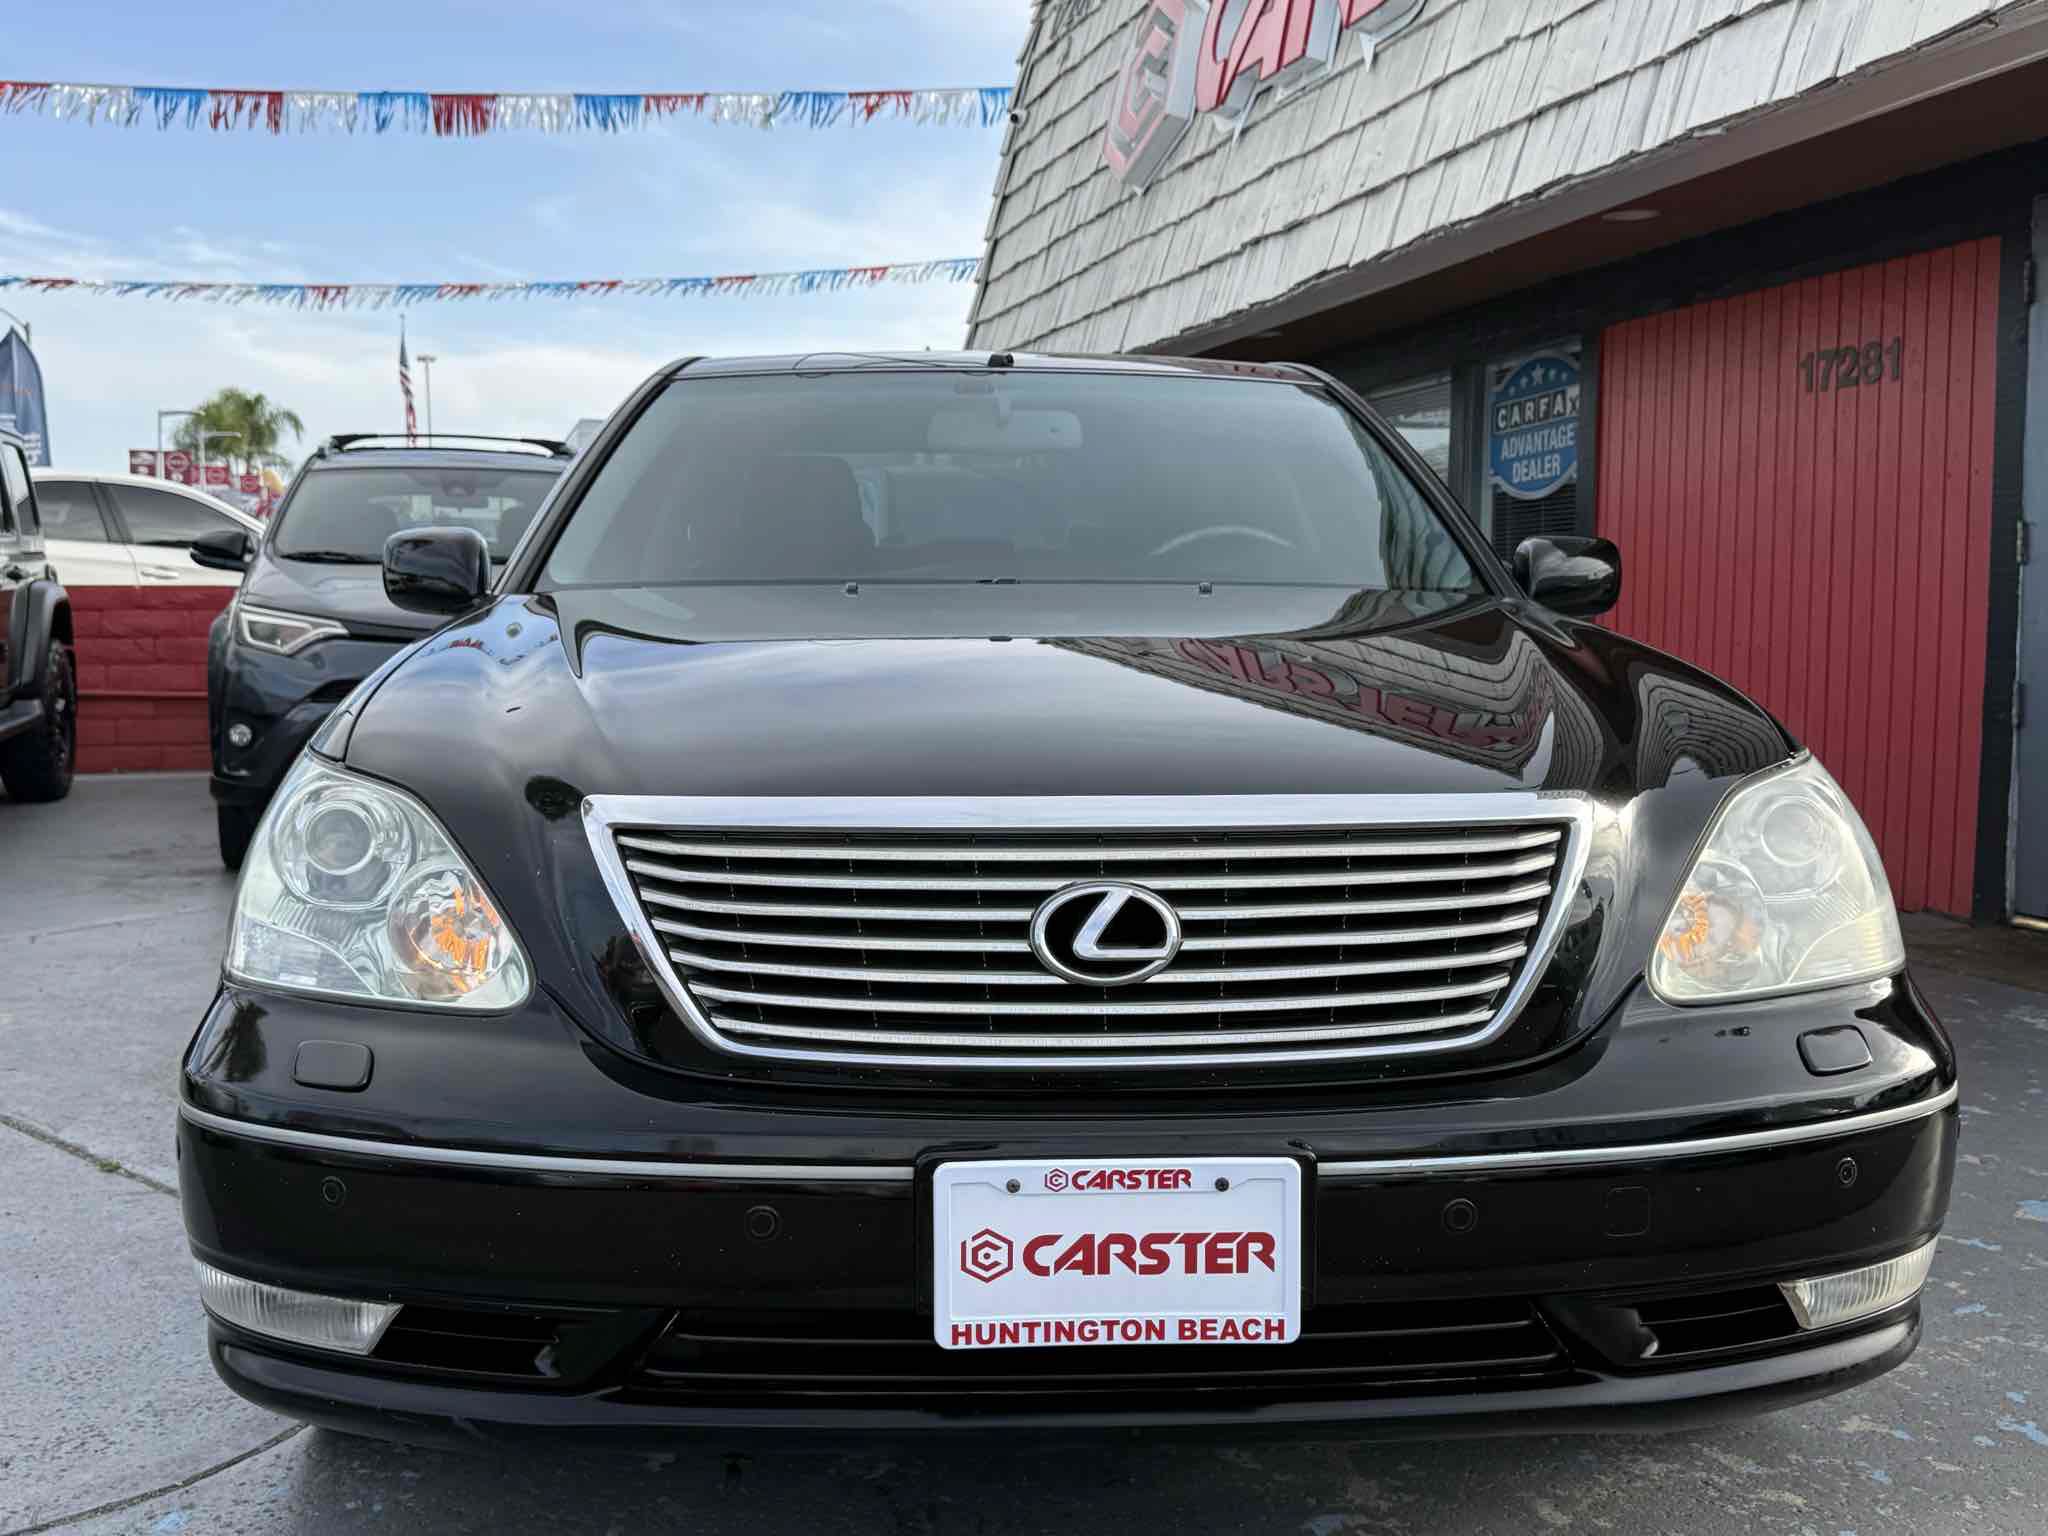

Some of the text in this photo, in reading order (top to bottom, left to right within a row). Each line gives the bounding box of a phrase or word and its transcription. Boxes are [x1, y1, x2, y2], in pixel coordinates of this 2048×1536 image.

[1800, 336, 1900, 392] 17281
[1501, 424, 1577, 460] ADVANTAGE
[1512, 453, 1561, 483] DEALER
[1071, 1168, 1191, 1190] CARSTER
[1022, 1231, 1275, 1277] CARSTER
[951, 1318, 1285, 1345] HUNTINGTON BEACH
